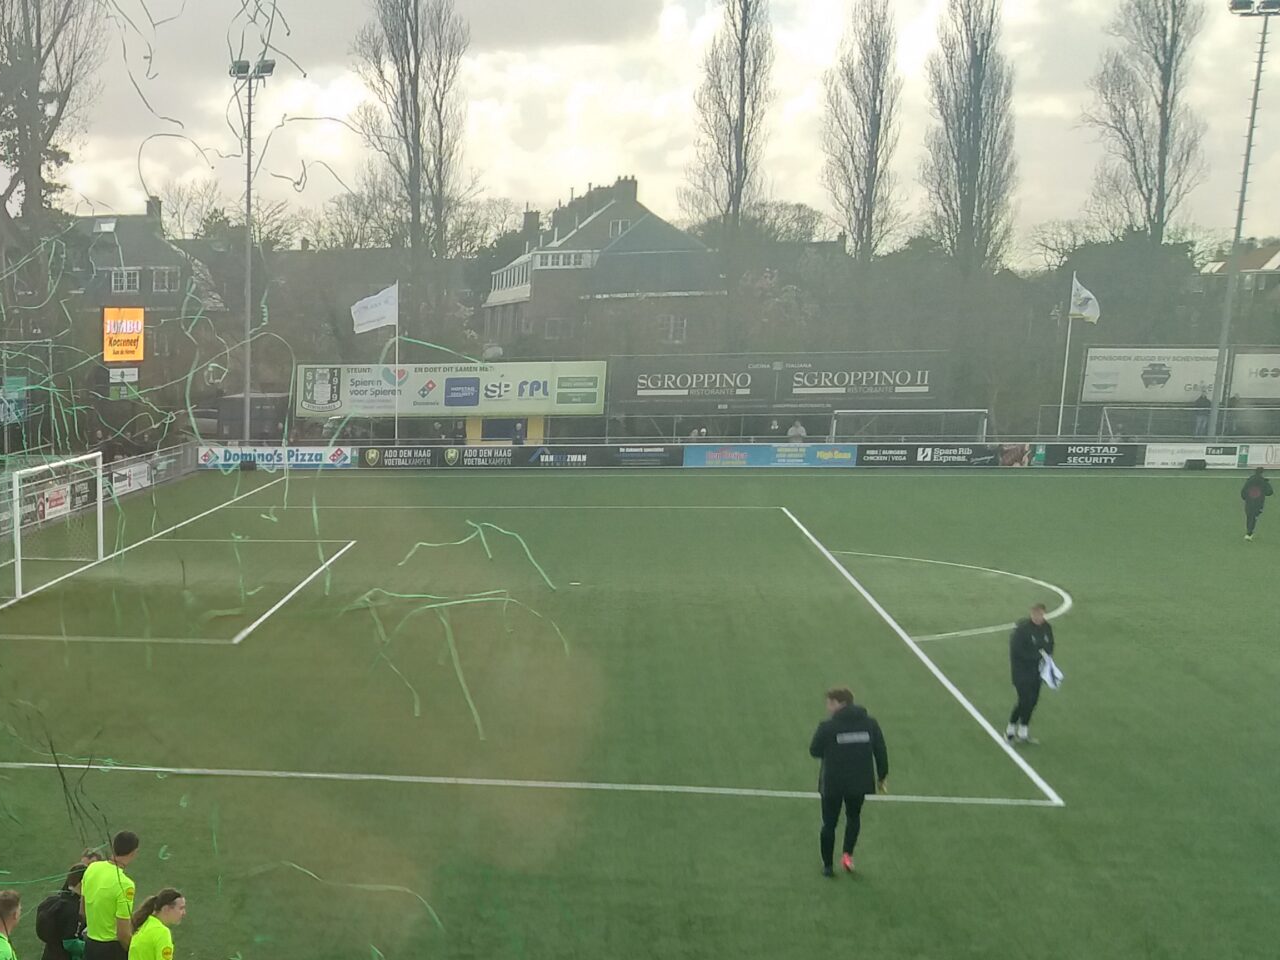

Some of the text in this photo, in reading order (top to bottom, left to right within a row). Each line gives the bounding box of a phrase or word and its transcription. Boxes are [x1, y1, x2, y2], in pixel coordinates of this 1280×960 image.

[106, 320, 142, 334] JUMBO
[637, 372, 751, 389] SGROPPINO
[793, 370, 911, 387] SGROPPINO
[349, 388, 368, 396] voor
[518, 380, 549, 397] FPL
[690, 388, 736, 396] RISTORANTE
[384, 449, 431, 458] ADO DEN HAAG
[464, 449, 510, 458] ADO DEN HAAG
[933, 447, 972, 456] Spare Rib
[1067, 446, 1118, 454] HOFSTAD
[223, 448, 323, 463] Domino's Pizza
[1067, 456, 1117, 464] SECURITY
[384, 458, 431, 466] VOETBALKAMPEN
[464, 458, 510, 466] VOETBALKAMPEN
